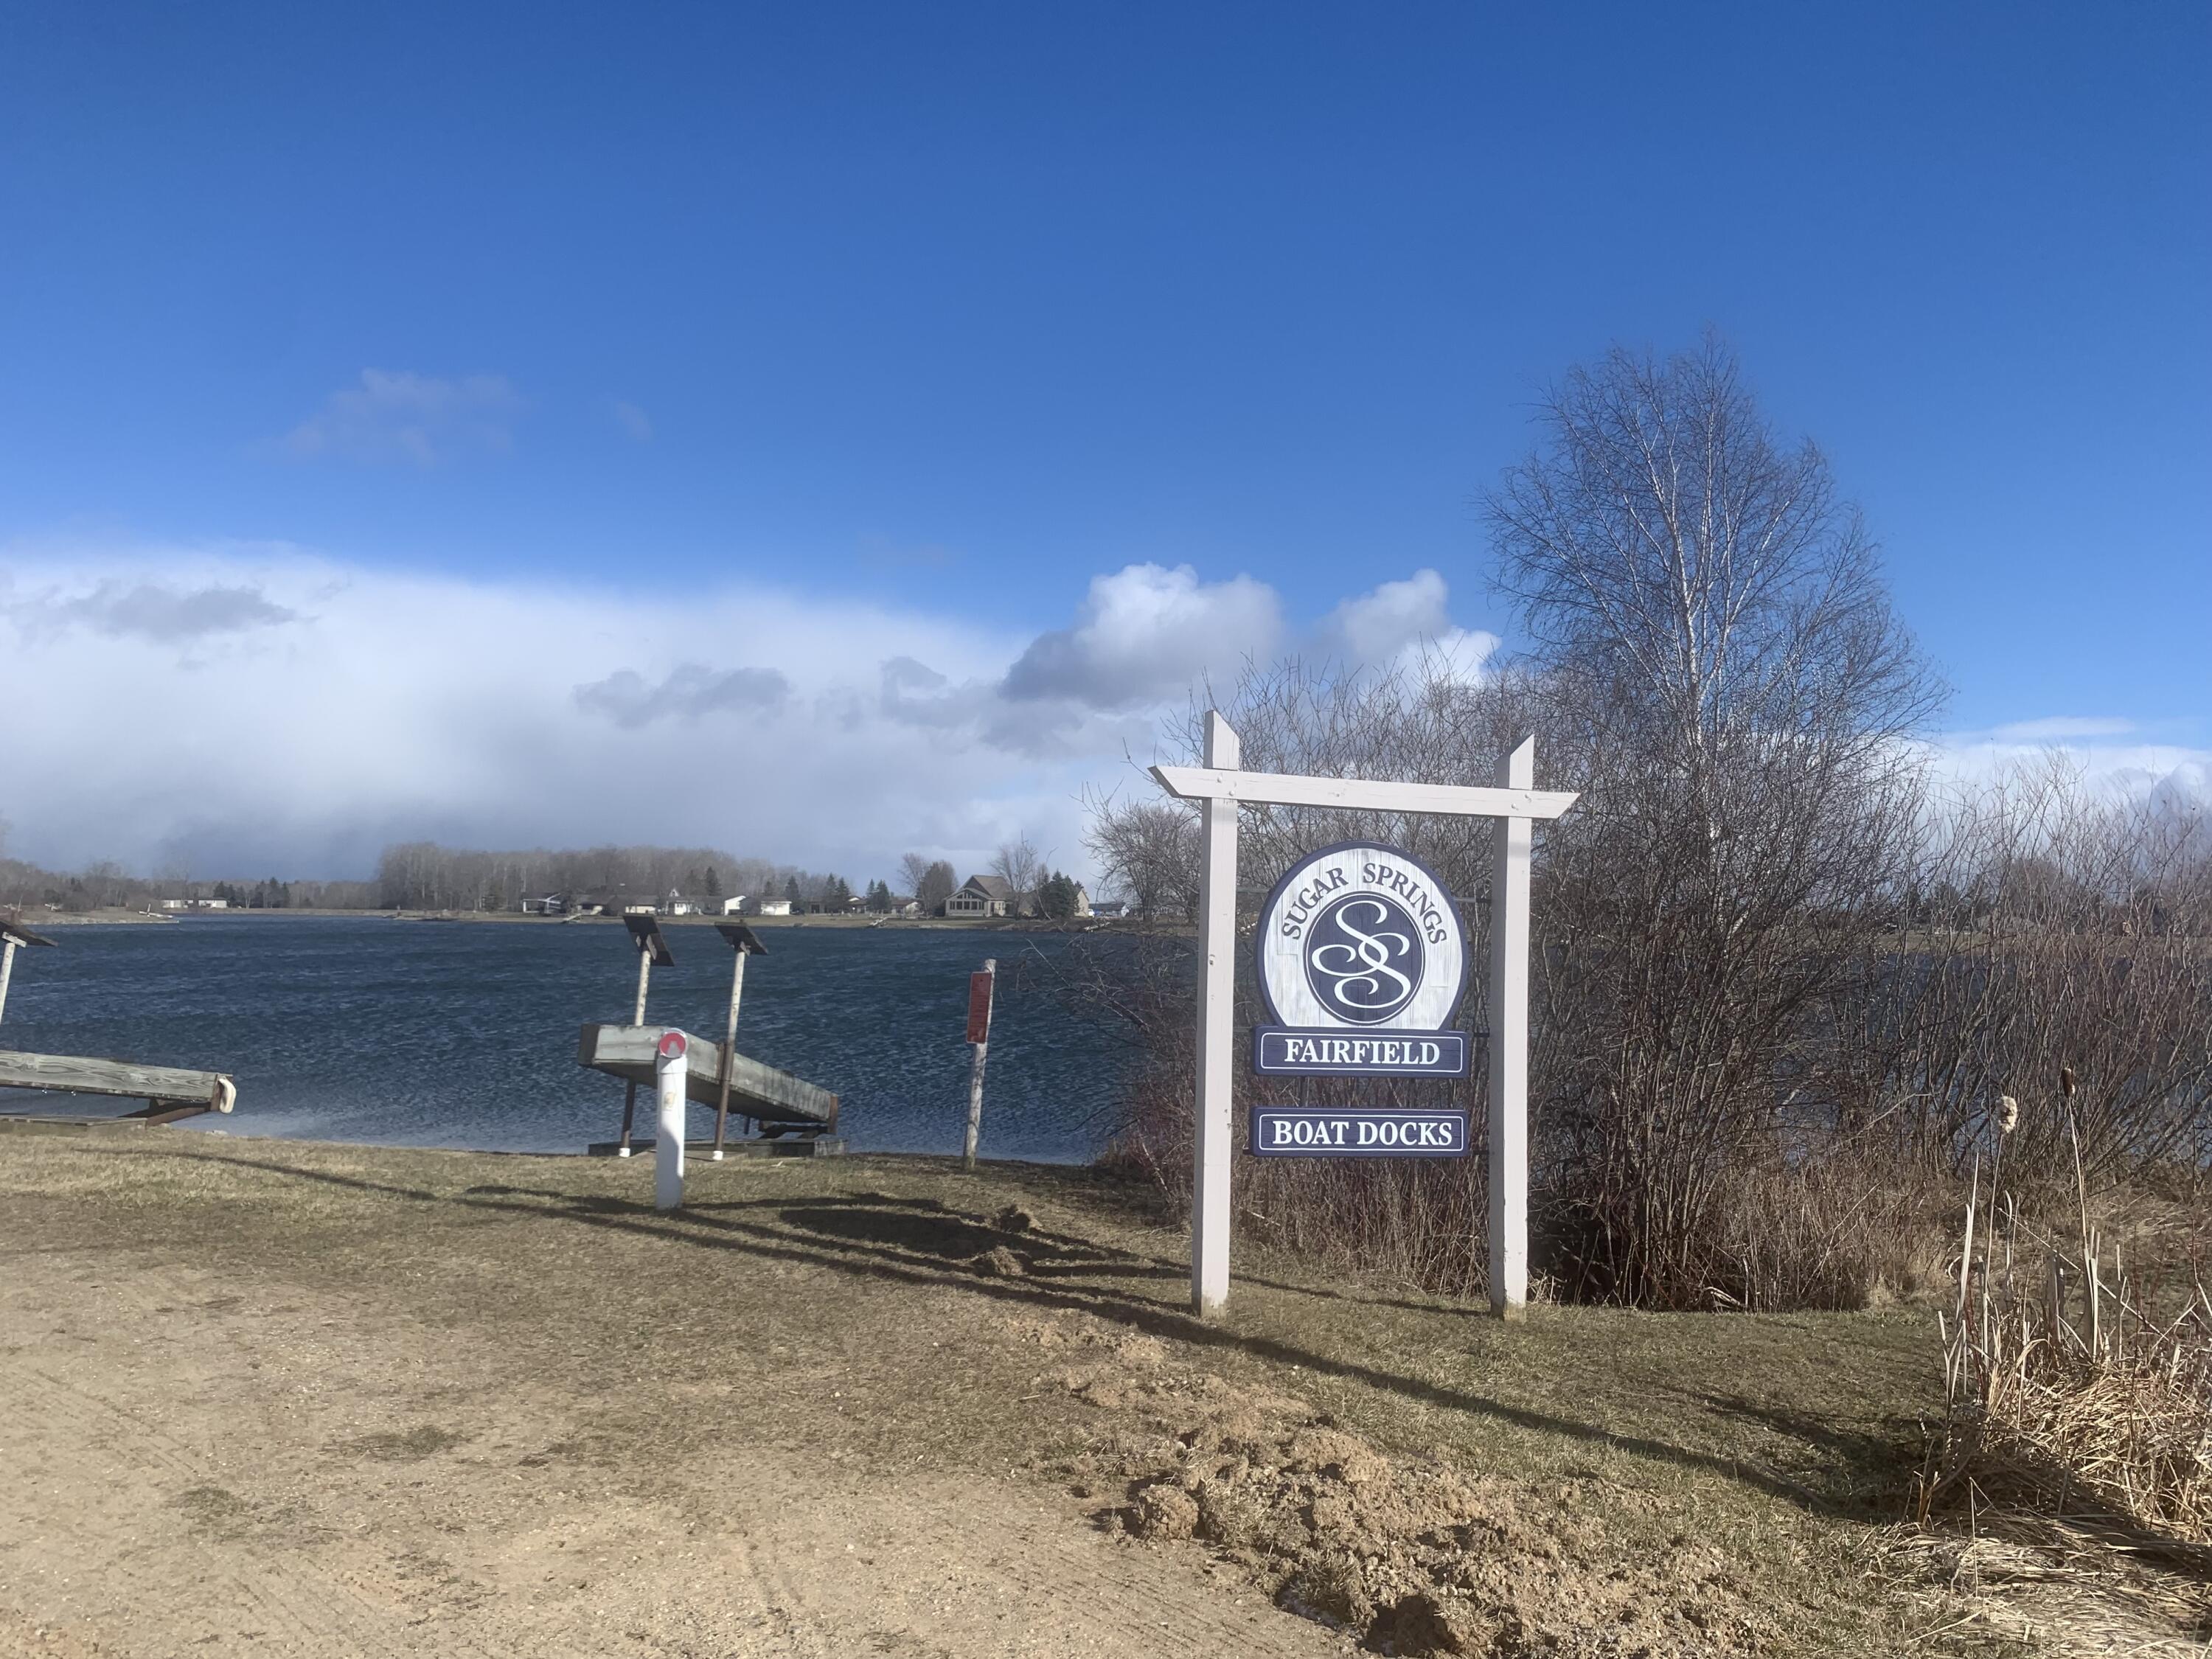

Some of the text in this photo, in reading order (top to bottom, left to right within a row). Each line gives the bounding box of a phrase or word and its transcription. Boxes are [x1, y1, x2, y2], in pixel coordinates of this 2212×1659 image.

[1281, 862, 1447, 945] SUGAR SPRINGS
[1284, 1038, 1440, 1065] FAIRFIELD
[1272, 1120, 1453, 1146] BOAT DOCKS
